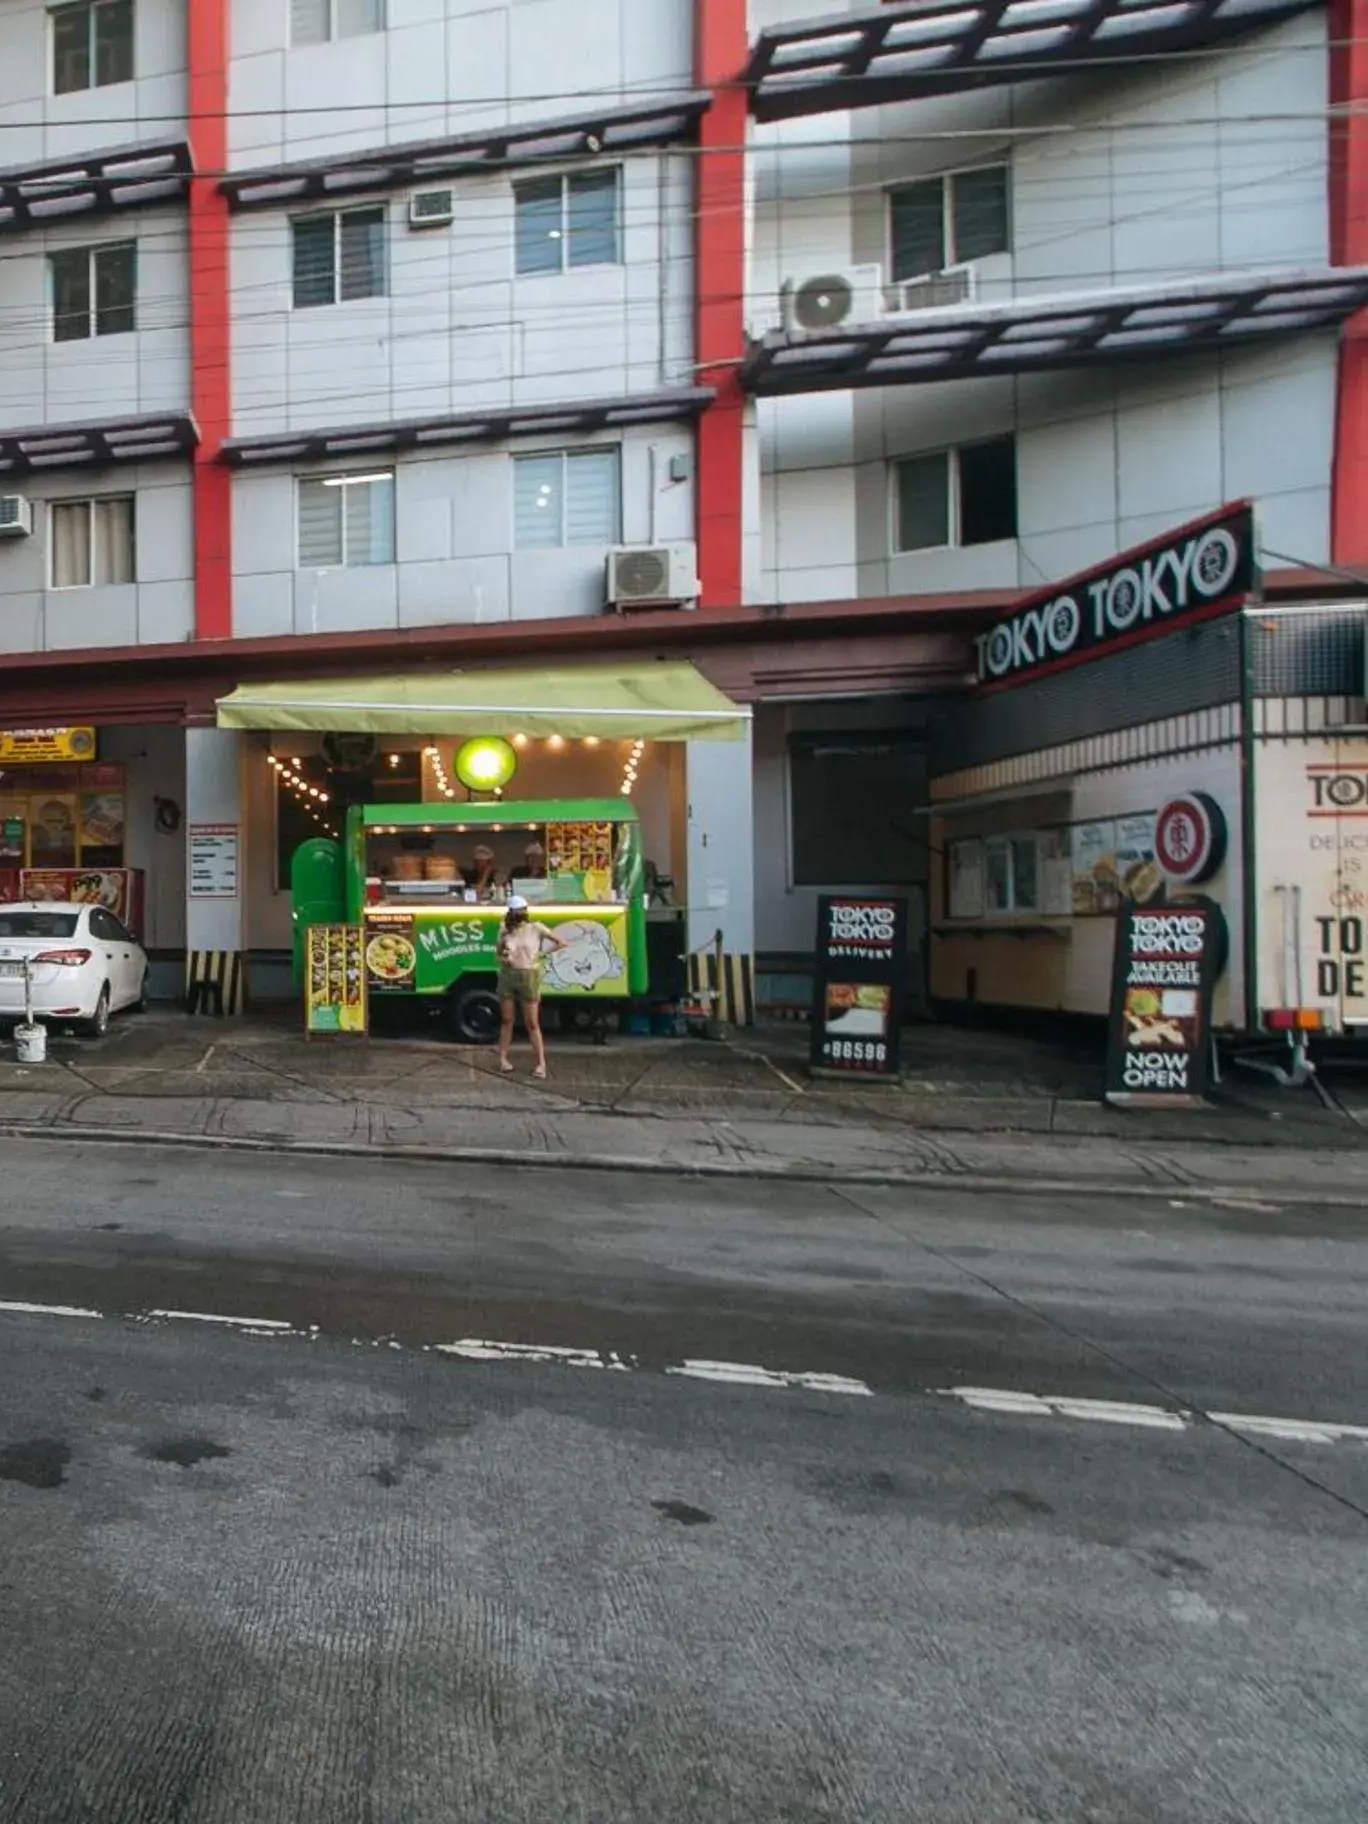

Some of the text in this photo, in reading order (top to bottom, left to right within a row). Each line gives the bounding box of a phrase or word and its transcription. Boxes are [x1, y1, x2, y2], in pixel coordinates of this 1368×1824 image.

[974, 528, 1237, 680] TOKYO TOKYO
[1307, 774, 1368, 806] TO
[830, 906, 896, 925] TOKYO
[1131, 915, 1206, 935] TOKYO
[419, 920, 485, 952] MISS
[829, 922, 895, 940] TOKYO
[432, 943, 481, 961] NOODLES
[828, 945, 894, 959] DELIVERY
[1130, 933, 1204, 954] TOKYO
[1131, 960, 1199, 973] TAKEOUT
[1127, 970, 1201, 985] AVAILABLE
[1318, 960, 1365, 997] DE
[1125, 1051, 1189, 1069] NOW
[1123, 1069, 1188, 1089] OPEN
